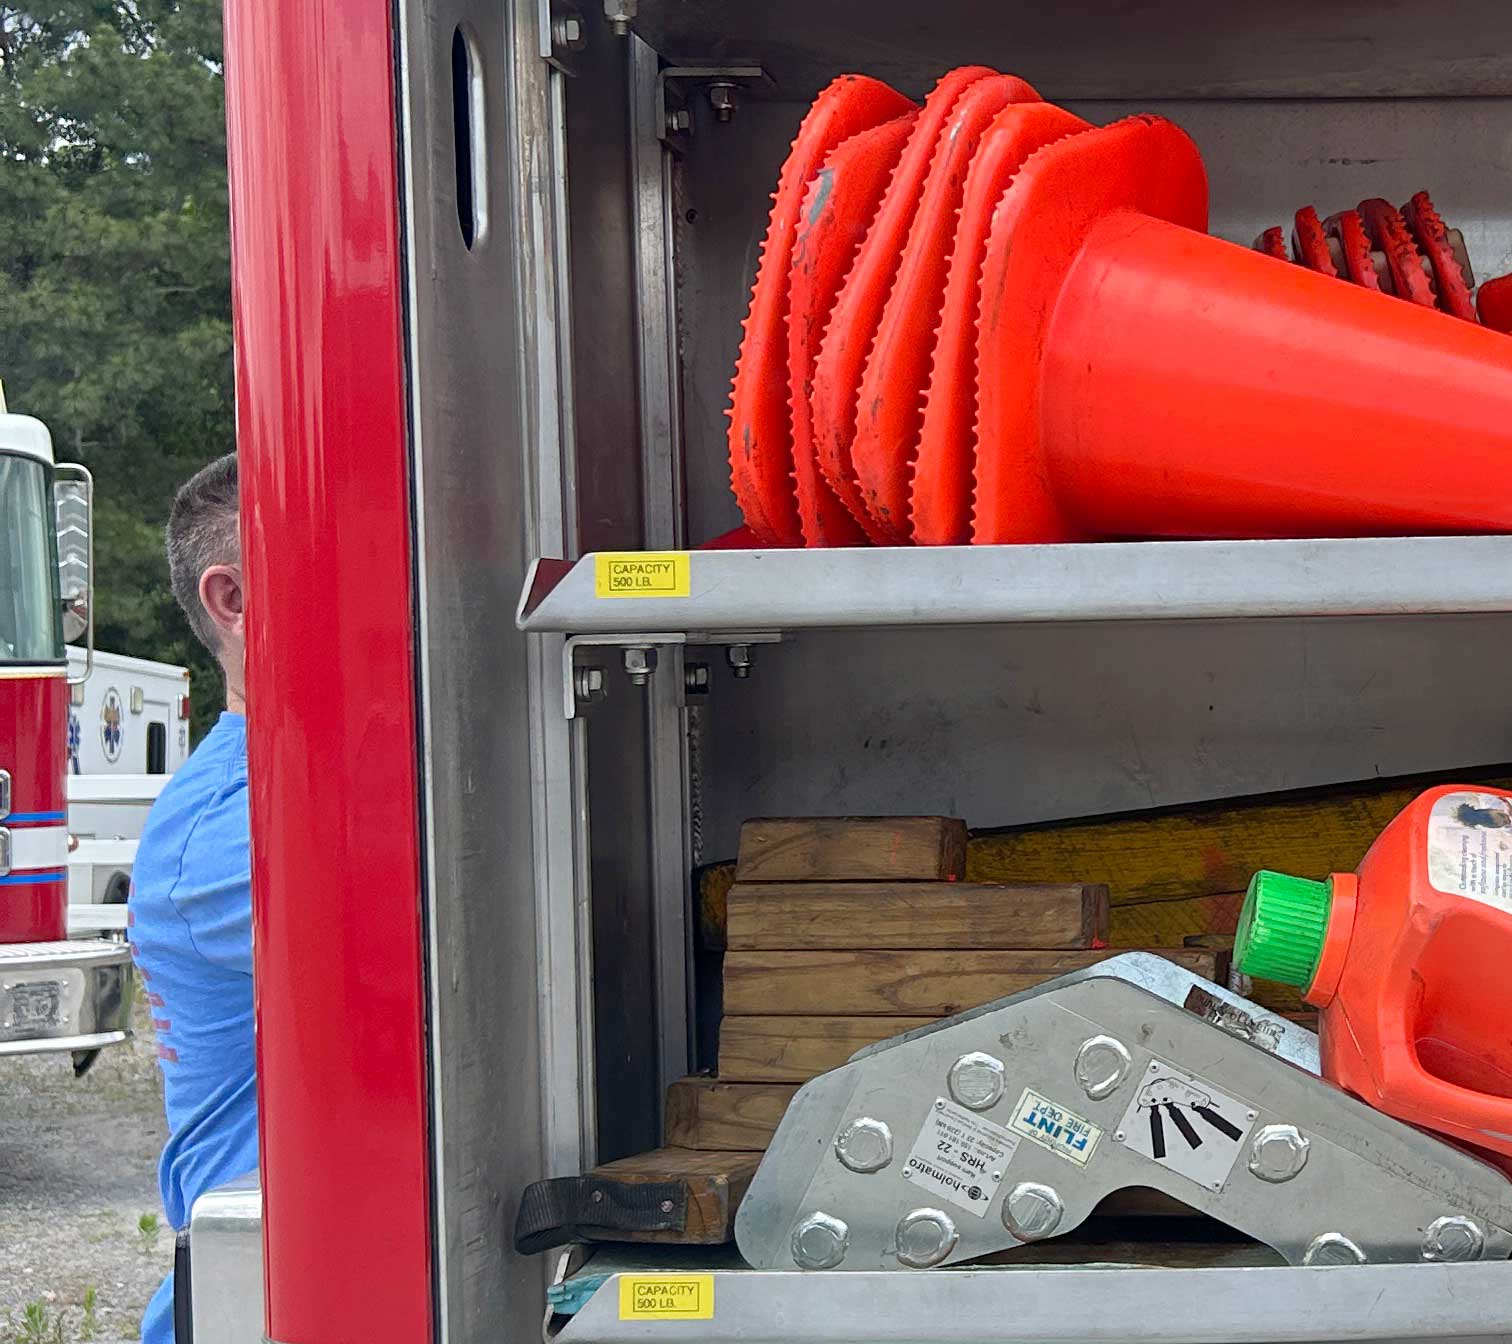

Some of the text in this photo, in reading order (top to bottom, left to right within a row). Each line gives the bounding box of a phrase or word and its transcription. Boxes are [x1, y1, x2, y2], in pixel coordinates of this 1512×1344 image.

[613, 564, 671, 575] CAPACITY
[613, 576, 633, 587] 500
[1023, 1111, 1088, 1151] FLINT
[1066, 1118, 1090, 1137] FIRE
[936, 1140, 952, 1154] 22
[960, 1152, 986, 1169] HRS
[909, 1158, 961, 1191] holmatro
[637, 1285, 694, 1296] CAPACITY
[637, 1298, 656, 1308] 500
